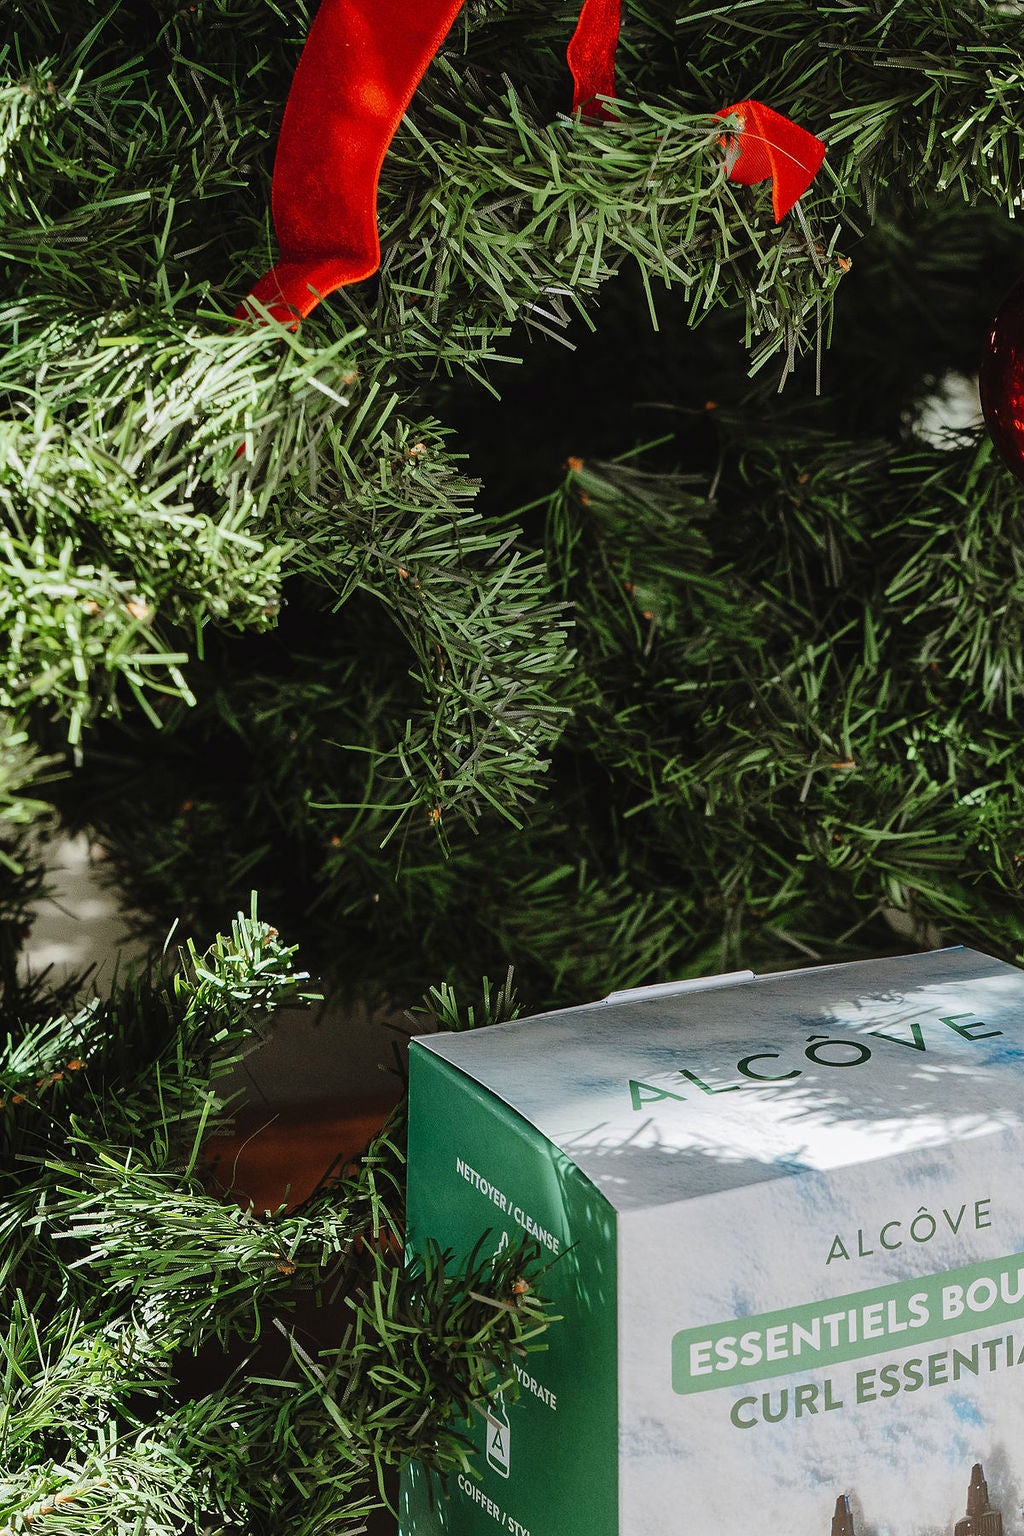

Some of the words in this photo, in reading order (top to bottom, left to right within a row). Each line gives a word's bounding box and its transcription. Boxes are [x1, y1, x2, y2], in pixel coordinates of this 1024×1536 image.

[628, 1012, 1003, 1111] ALCÔVE
[456, 1157, 507, 1212] NETTOYER
[514, 1207, 560, 1255] CLEANSE
[825, 1199, 993, 1265] ALCÔVE
[689, 1292, 930, 1376] ESSENTIELS
[513, 1363, 557, 1411] YDRATE
[730, 1378, 844, 1430] CURL
[457, 1473, 500, 1521] COIFFER
